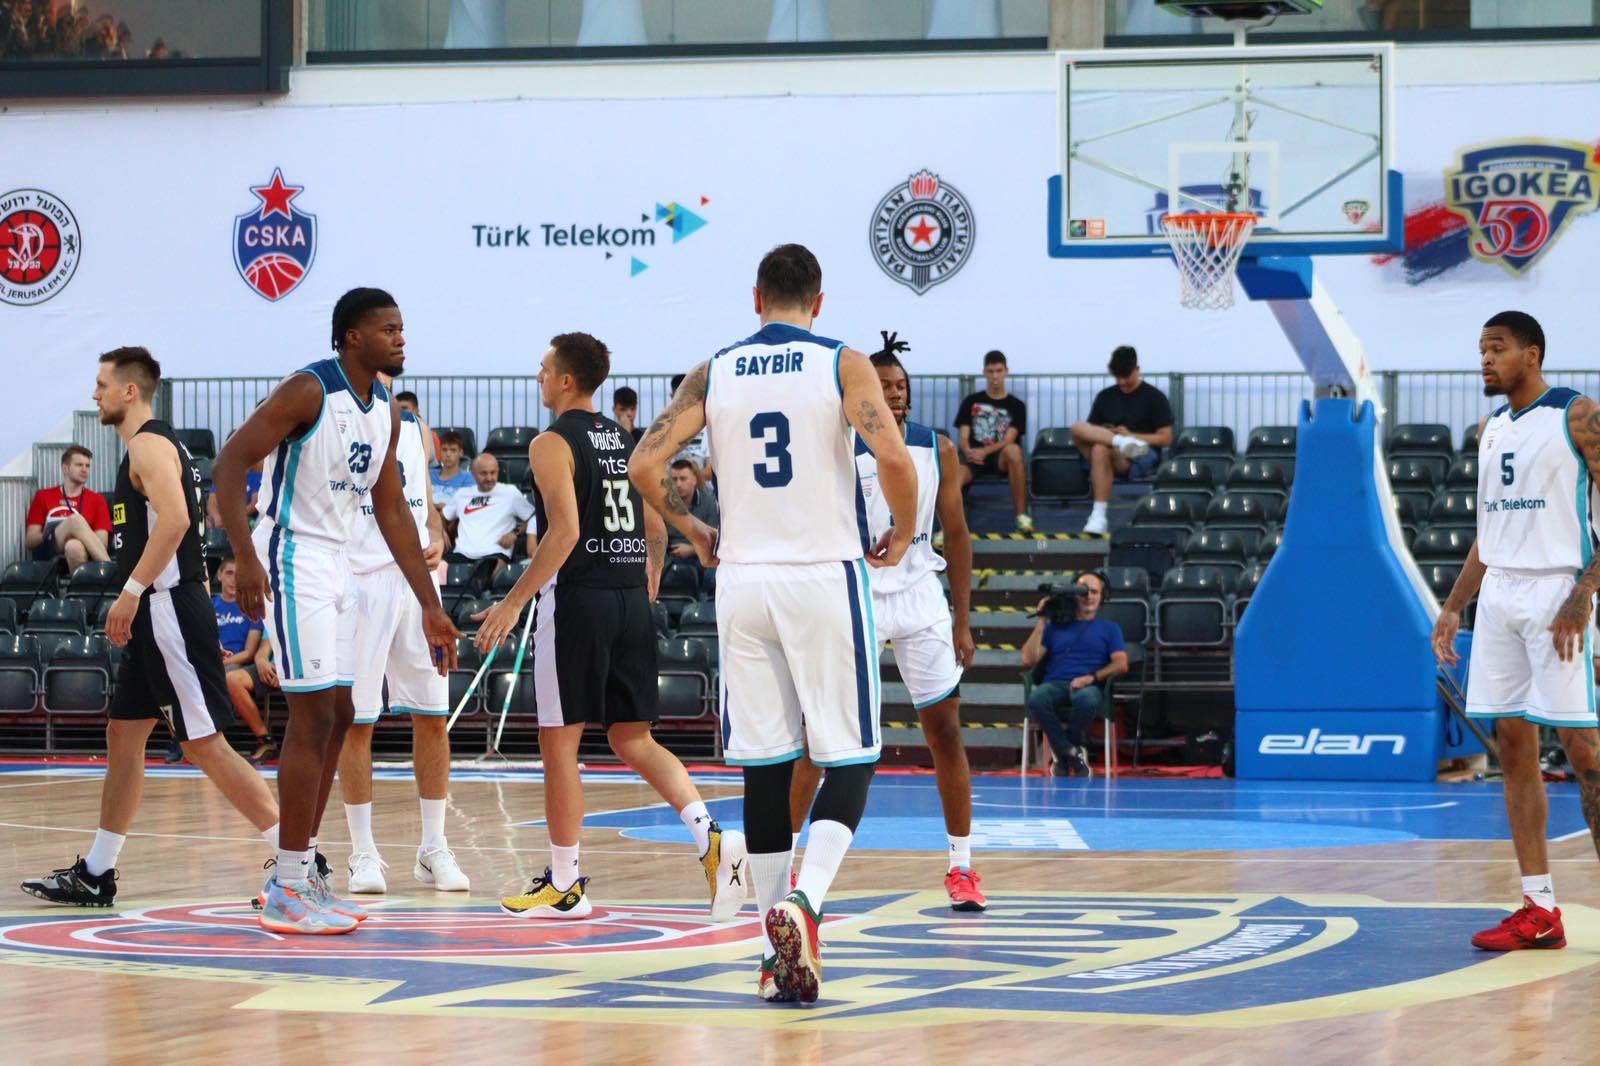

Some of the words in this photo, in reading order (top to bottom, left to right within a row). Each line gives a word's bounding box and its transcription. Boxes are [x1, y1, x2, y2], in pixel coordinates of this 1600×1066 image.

[1452, 172, 1592, 201] IGOKEA
[0, 196, 30, 214] ירוש
[245, 225, 306, 247] CSKA
[471, 224, 530, 247] Türk
[541, 224, 656, 246] Telekom
[876, 193, 905, 275] PARTIZAN
[937, 192, 968, 274] ПАРТИЗАН
[1474, 200, 1549, 257] 50
[7, 275, 62, 299] JERUSALEM
[348, 441, 372, 473] 23
[749, 411, 793, 488] 3
[1501, 452, 1515, 486] 5
[602, 479, 635, 532] 33
[1500, 497, 1546, 511] Telekom
[585, 538, 646, 553] GLOBOS
[1258, 728, 1406, 755] elan
